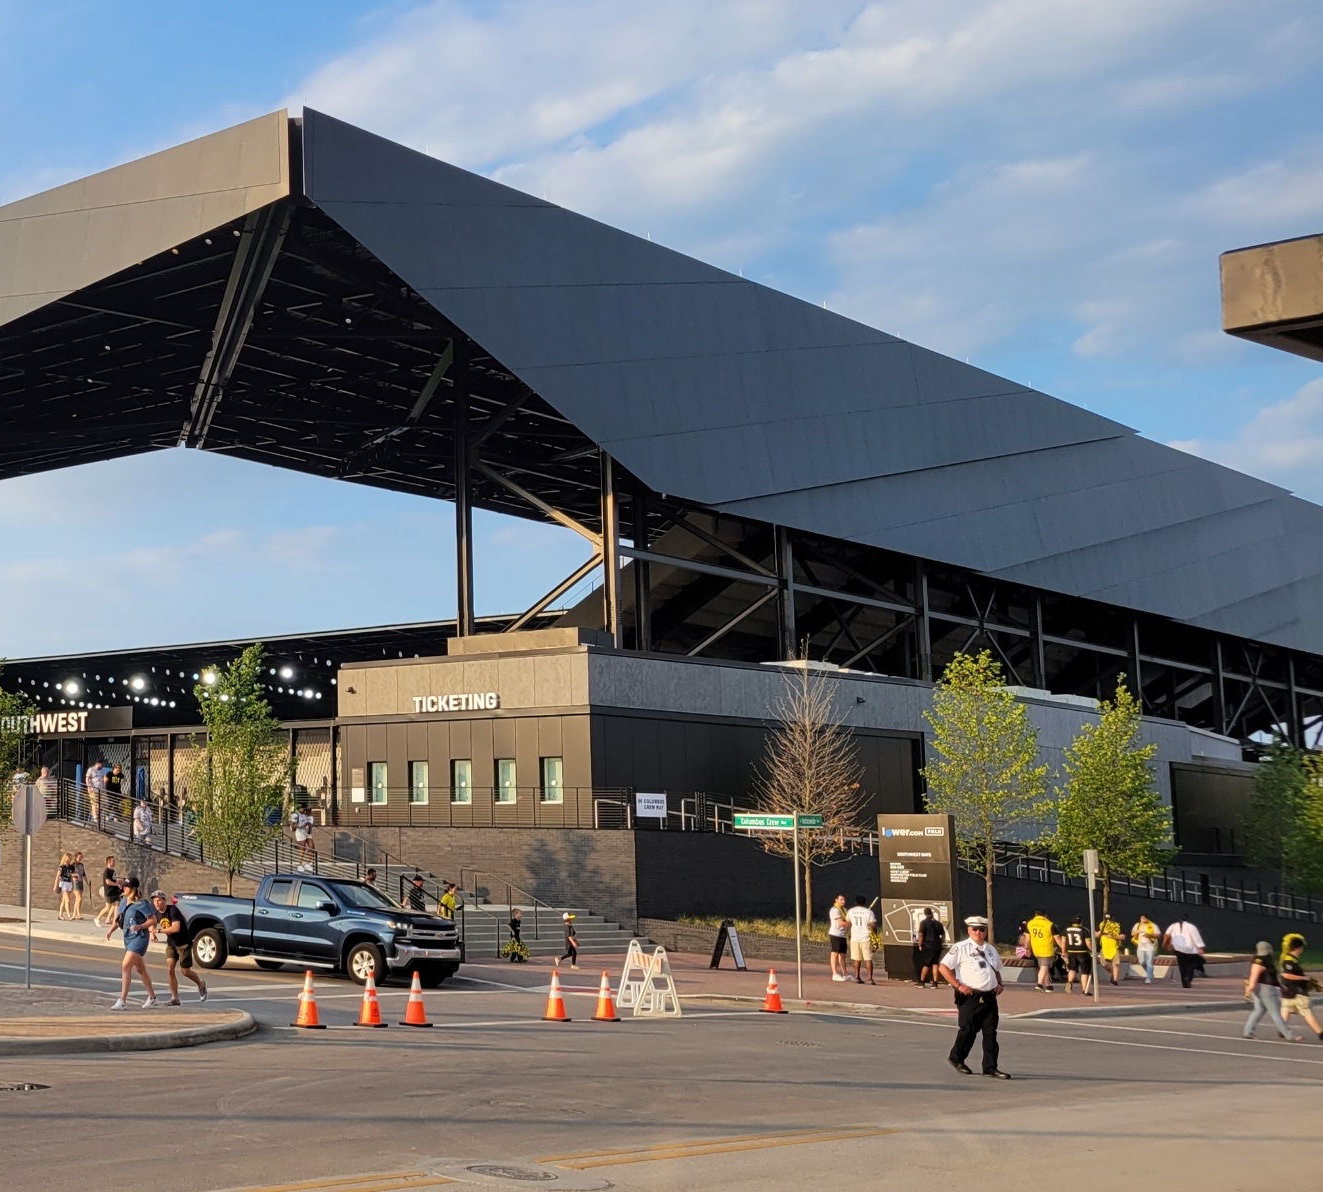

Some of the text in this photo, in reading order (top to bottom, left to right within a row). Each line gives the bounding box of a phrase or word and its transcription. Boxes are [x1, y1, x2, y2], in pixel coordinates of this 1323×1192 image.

[412, 692, 499, 713] TICKETING
[740, 817, 765, 826] Columbus
[766, 818, 780, 827] Crew
[1032, 928, 1044, 939] 96
[1067, 933, 1082, 946] 13
